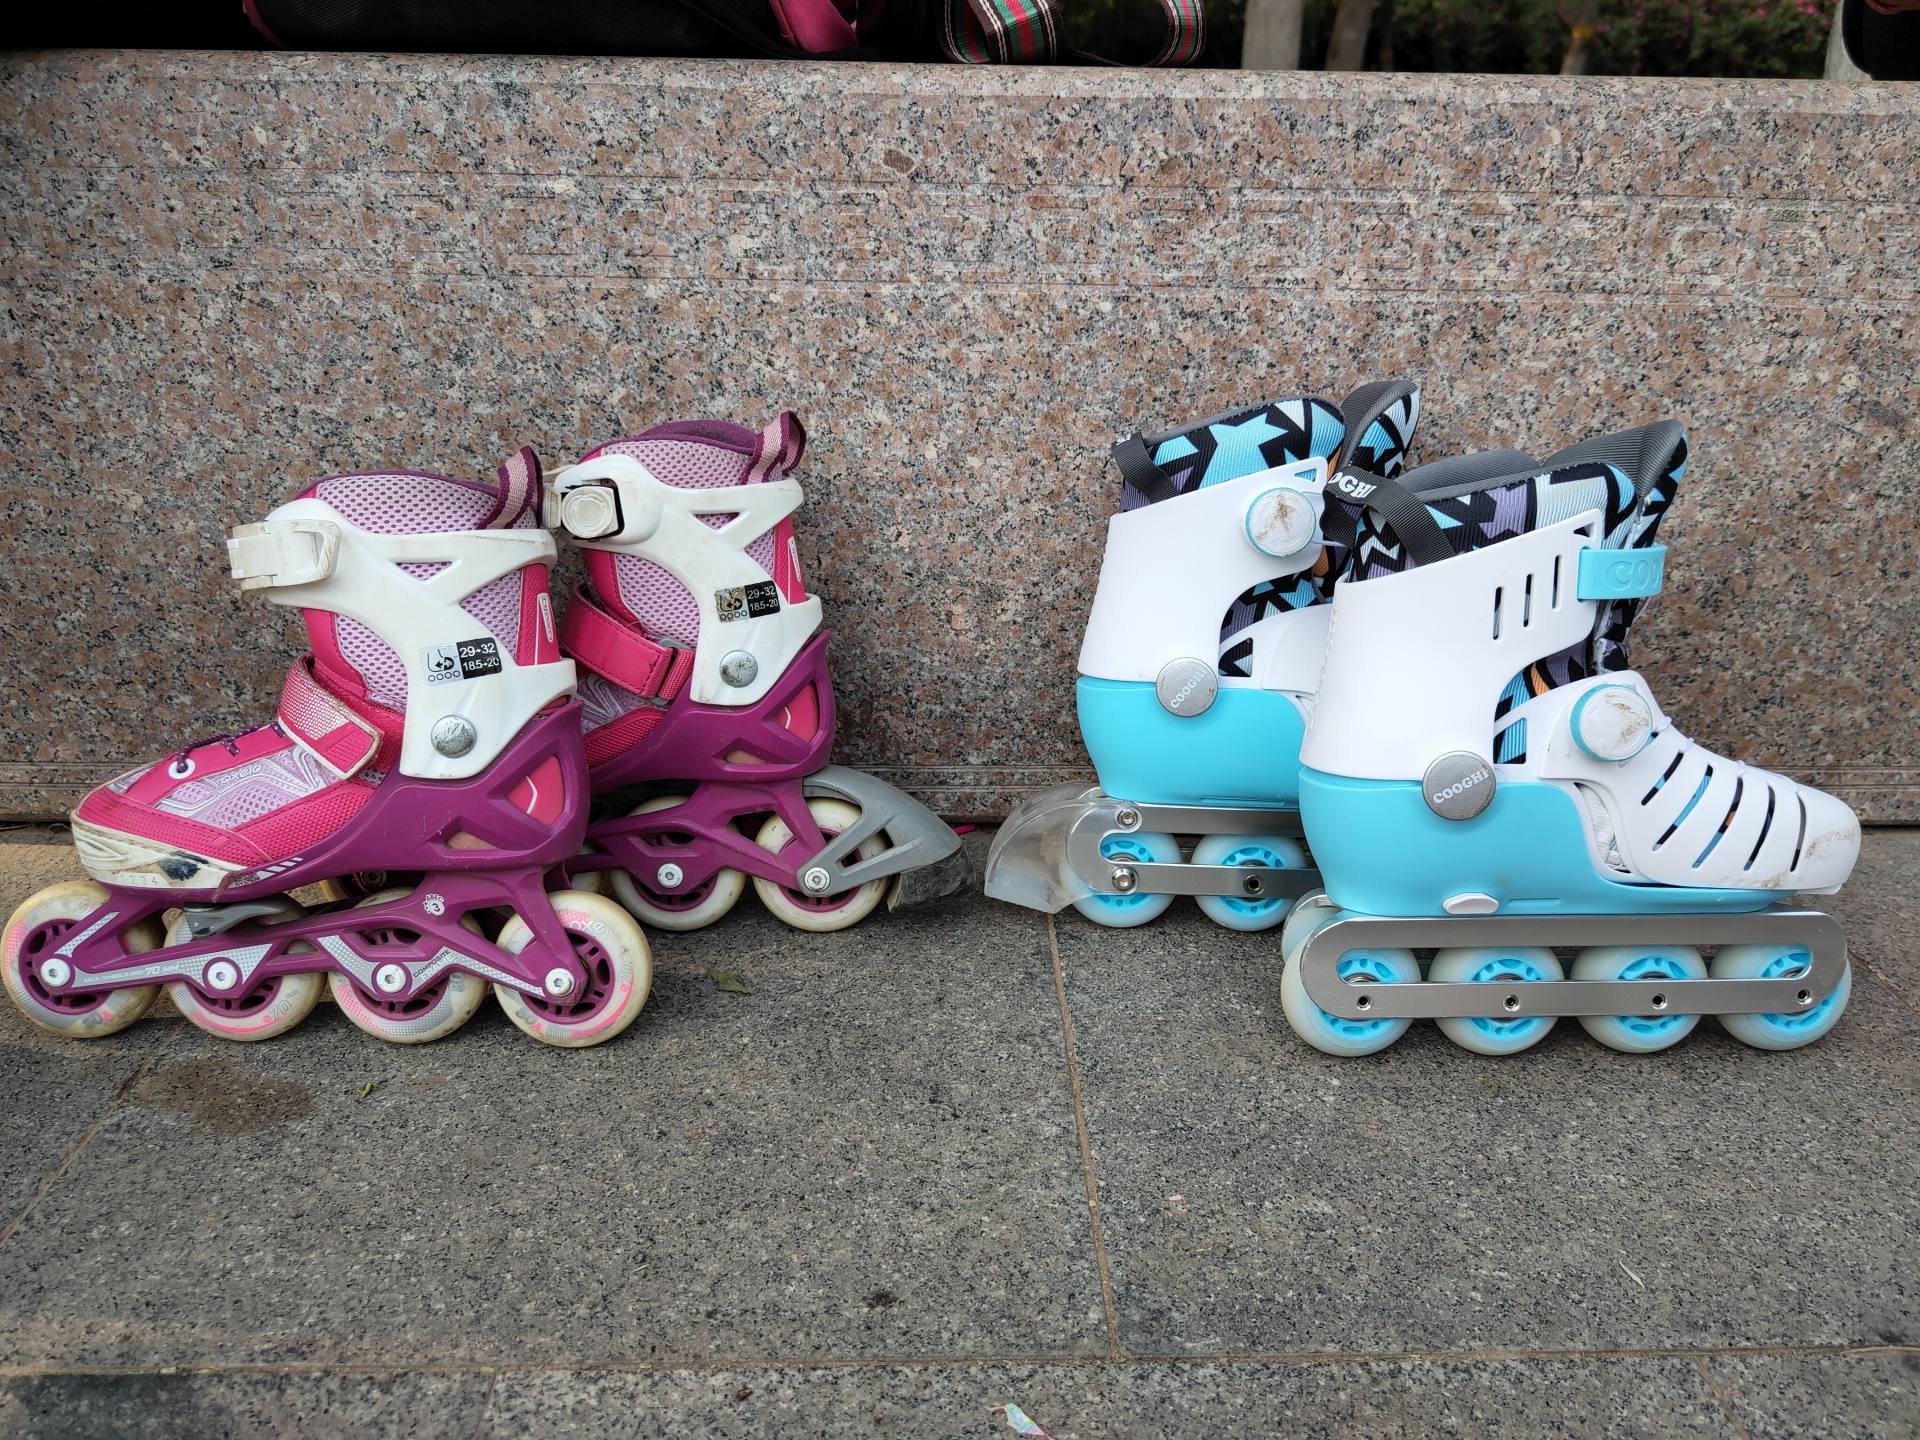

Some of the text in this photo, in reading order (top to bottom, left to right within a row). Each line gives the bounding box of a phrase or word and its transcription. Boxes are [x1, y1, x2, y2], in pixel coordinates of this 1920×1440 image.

[1170, 667, 1208, 709] COOGHI
[1432, 767, 1490, 804] COOGHI
[431, 902, 441, 912] 3
[413, 949, 451, 978] COMPOSITE
